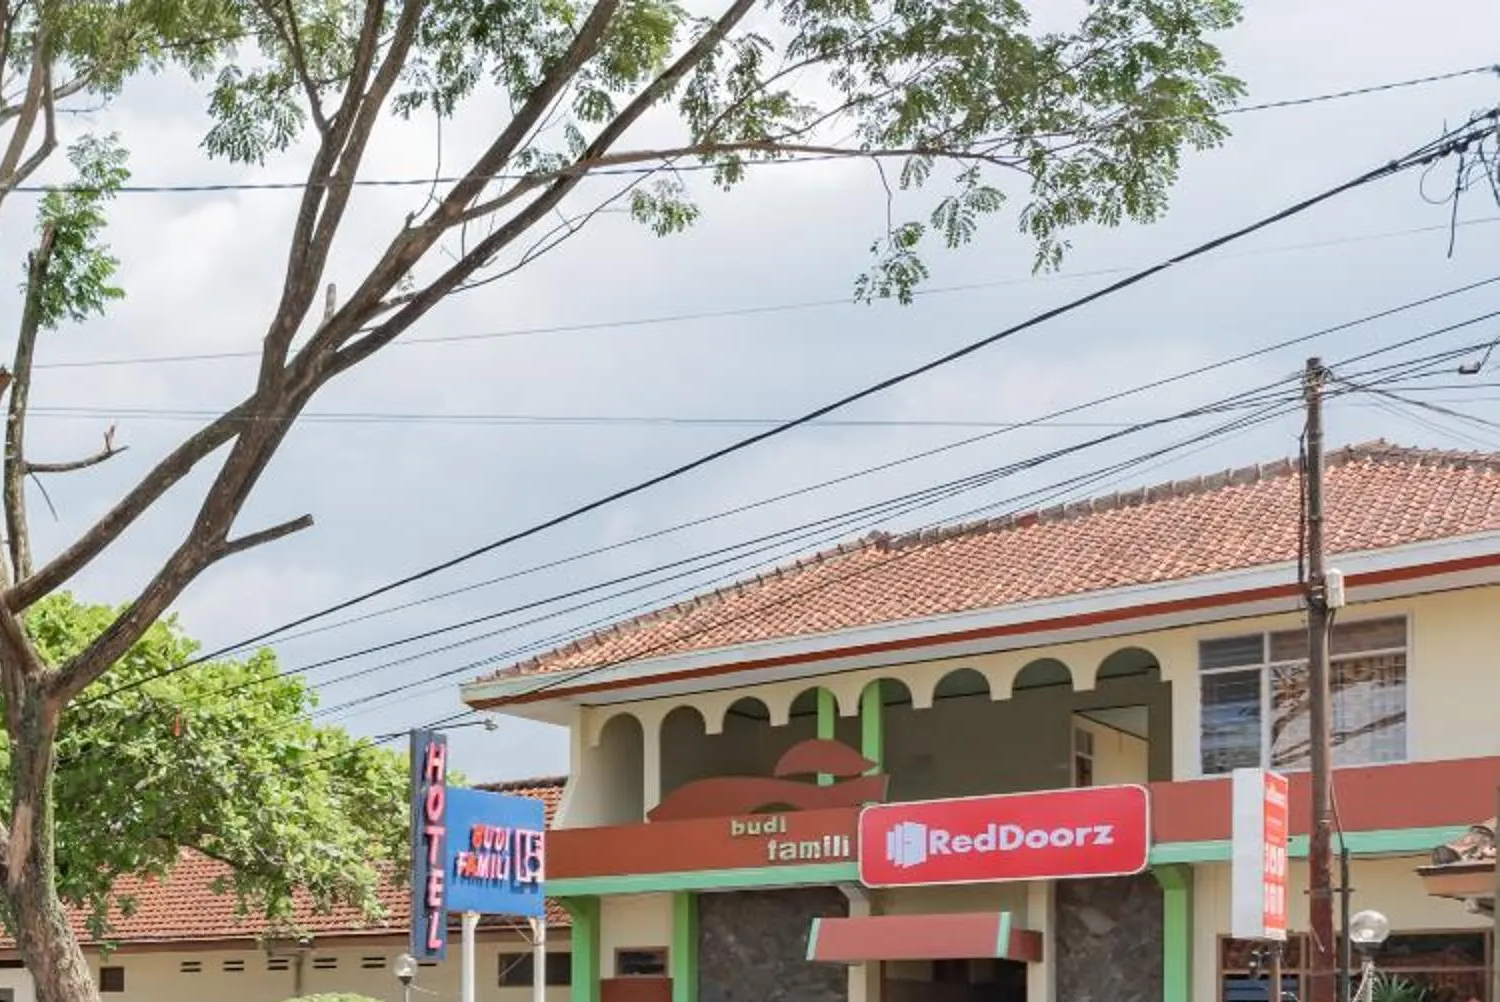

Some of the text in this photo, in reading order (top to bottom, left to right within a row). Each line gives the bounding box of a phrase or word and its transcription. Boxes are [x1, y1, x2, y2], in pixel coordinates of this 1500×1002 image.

[731, 815, 787, 836] budi
[928, 822, 1114, 855] RedDoorz
[425, 740, 448, 950] HOTEL
[767, 835, 850, 861] famili
